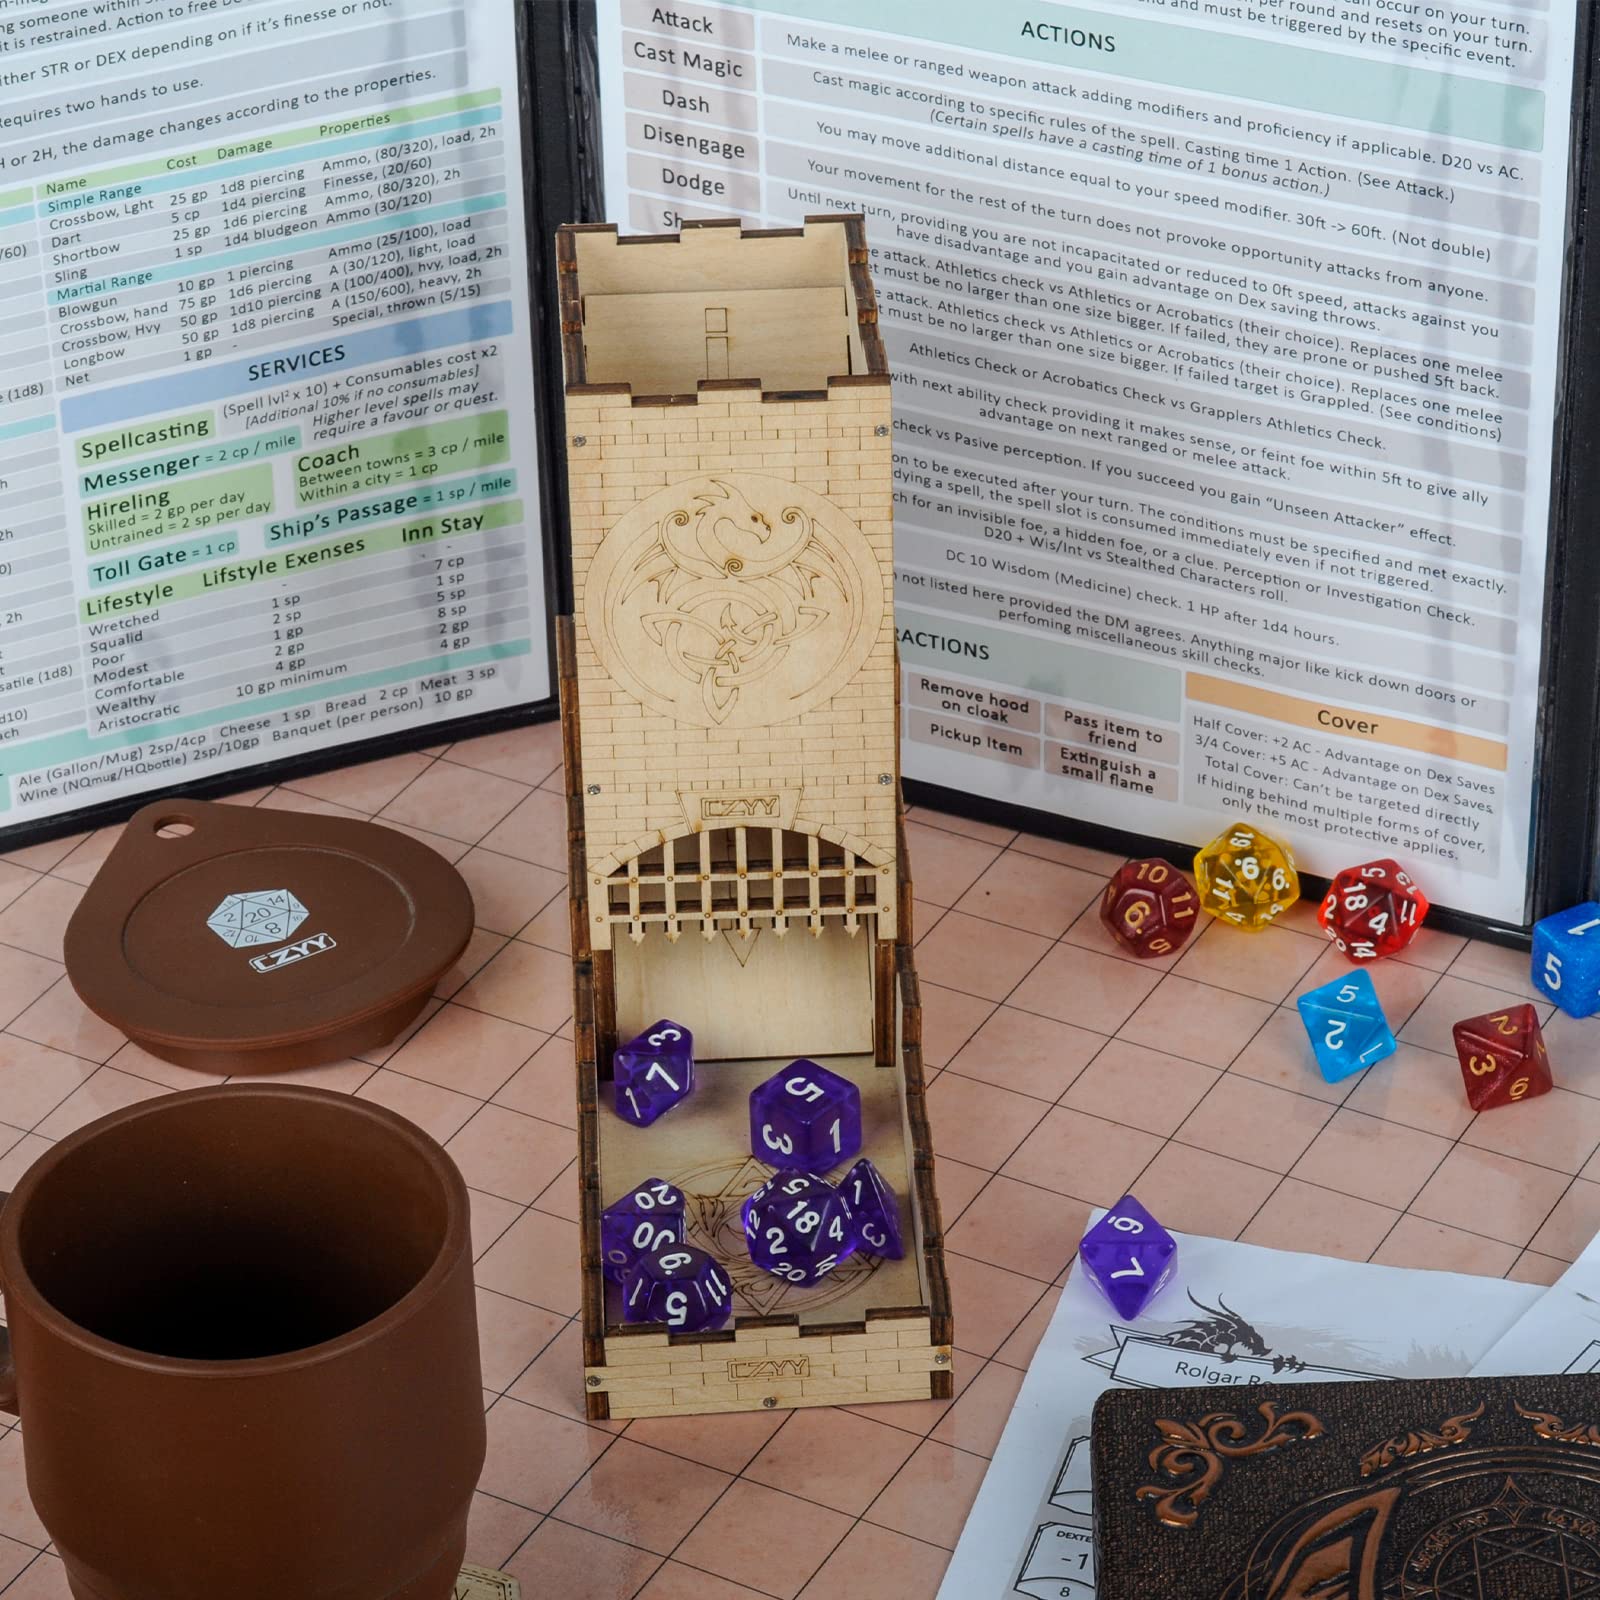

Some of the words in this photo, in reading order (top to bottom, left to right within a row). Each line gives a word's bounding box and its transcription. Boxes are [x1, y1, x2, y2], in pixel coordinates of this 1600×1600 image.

[652, 8, 714, 34] Attack
[41, 62, 69, 78] STR
[74, 60, 91, 71] or
[96, 50, 126, 67] DEX
[132, 34, 214, 60] depending
[218, 29, 237, 40] on
[242, 22, 252, 36] if
[284, 8, 336, 27] finesse
[342, 3, 358, 15] or
[1021, 21, 1116, 52] ACTIONS
[1204, 4, 1242, 19] must
[1248, 7, 1266, 22] be
[1270, 13, 1342, 37] triggered
[1348, 26, 1366, 44] by
[1371, 30, 1397, 46] the
[1401, 39, 1464, 58] specific
[1466, 50, 1516, 68] event.
[634, 42, 676, 64] Cast
[684, 51, 742, 78] Magic
[662, 90, 710, 114] Dash
[788, 33, 826, 51] Make
[832, 44, 839, 53] a
[844, 46, 888, 62] melee
[894, 56, 910, 66] or
[914, 59, 964, 76] ranged
[968, 69, 1026, 88] weapon
[1032, 82, 1077, 98] attack
[1082, 89, 1132, 110] adding
[1138, 101, 1208, 122] modifiers
[1213, 115, 1242, 128] and
[1248, 120, 1331, 147] proficiency
[1337, 134, 1347, 148] if
[1352, 140, 1436, 164] applicable.
[1442, 154, 1472, 170] D20
[1476, 163, 1493, 174] vs
[1498, 165, 1523, 180] AC.
[10, 155, 28, 166] or
[32, 147, 57, 162] 2H,
[62, 141, 88, 155] the
[93, 129, 154, 148] damage
[160, 114, 221, 135] changes
[226, 97, 300, 121] according
[304, 94, 319, 104] to
[324, 86, 349, 100] the
[354, 70, 436, 96] properties.
[46, 178, 86, 195] Name
[166, 155, 198, 170] Cost
[218, 140, 272, 160] Damage
[320, 114, 390, 138] Properties
[644, 124, 744, 160] Disengage
[662, 168, 725, 196] Dodge
[48, 194, 95, 213] Simple
[99, 185, 142, 203] Range
[51, 233, 82, 250] Dart
[53, 243, 120, 266] Shortbow
[54, 268, 88, 284] Sling
[57, 280, 106, 301] Martial
[110, 272, 152, 290] Range
[64, 348, 125, 370] Longbow
[248, 345, 346, 381] SERVICES
[65, 372, 90, 387] Net
[909, 342, 970, 366] Athletics
[975, 357, 1018, 376] Check
[1022, 369, 1038, 379] or
[1042, 370, 1118, 395] Acrobatics
[1123, 387, 1166, 406] Check
[1170, 400, 1185, 410] vs
[1190, 401, 1262, 426] Grapplers
[1266, 417, 1332, 439] Athletics
[1336, 430, 1386, 450] Check.
[80, 420, 209, 460] Spellcasting
[298, 444, 359, 472] Coach
[299, 465, 362, 488] Between
[366, 454, 410, 470] towns
[84, 455, 200, 492] Messenger
[87, 491, 170, 521] Hireling
[338, 496, 418, 524] Passage
[402, 526, 433, 543] Inn
[441, 515, 484, 534] Stay
[92, 560, 130, 582] Toll
[138, 550, 186, 571] Gate
[203, 560, 277, 587] Lifstyle
[285, 539, 365, 569] Exenses
[86, 584, 173, 616] Lifestyle
[88, 609, 159, 636] Wretched
[90, 630, 144, 653] Squalid
[92, 653, 125, 669] Poor
[93, 662, 149, 685] Modest
[94, 671, 184, 700] Comfortable
[420, 675, 458, 692] Meat
[921, 678, 983, 702] Remove
[989, 692, 1029, 714] hood
[96, 694, 156, 716] Wealthy
[326, 694, 366, 713] Bread
[942, 700, 960, 712] on
[966, 704, 1008, 724] cloak
[98, 704, 180, 732] Aristocratic
[220, 719, 271, 738] Cheese
[272, 720, 332, 742] Banquet
[1064, 710, 1098, 728] Pass
[1104, 719, 1140, 739] item
[1145, 730, 1162, 743] to
[1318, 710, 1379, 734] Cover
[931, 723, 981, 748] Pickup
[987, 736, 1022, 756] Item
[1088, 730, 1136, 753] friend
[1061, 747, 1142, 777] Extinguish
[1148, 770, 1156, 779] a
[19, 774, 41, 788] Ale
[1062, 765, 1104, 782] small
[1110, 774, 1154, 794] flame
[20, 787, 58, 802] Wine
[1324, 822, 1398, 845] protective
[1403, 840, 1458, 860] applies.
[1136, 863, 1168, 883] 10
[267, 894, 284, 906] 14
[1324, 894, 1337, 919] 2
[1343, 882, 1368, 911] 18
[245, 907, 271, 923] 20
[265, 922, 281, 934] 8
[1368, 912, 1389, 935] 4
[1544, 952, 1562, 990] 5
[1336, 985, 1360, 1002] 5
[1325, 1019, 1346, 1050] 2
[1469, 1054, 1496, 1076] 3
[785, 1077, 824, 1102] 5
[762, 1124, 793, 1155] 3
[830, 1119, 840, 1153] 1
[854, 1180, 862, 1205] 1
[787, 1201, 820, 1233] 18
[829, 1216, 843, 1241] 4
[766, 1227, 788, 1254] 2
[1175, 1361, 1242, 1385] Rolgar
[1061, 1553, 1088, 1570] -1
[1060, 1587, 1071, 1597] 8
